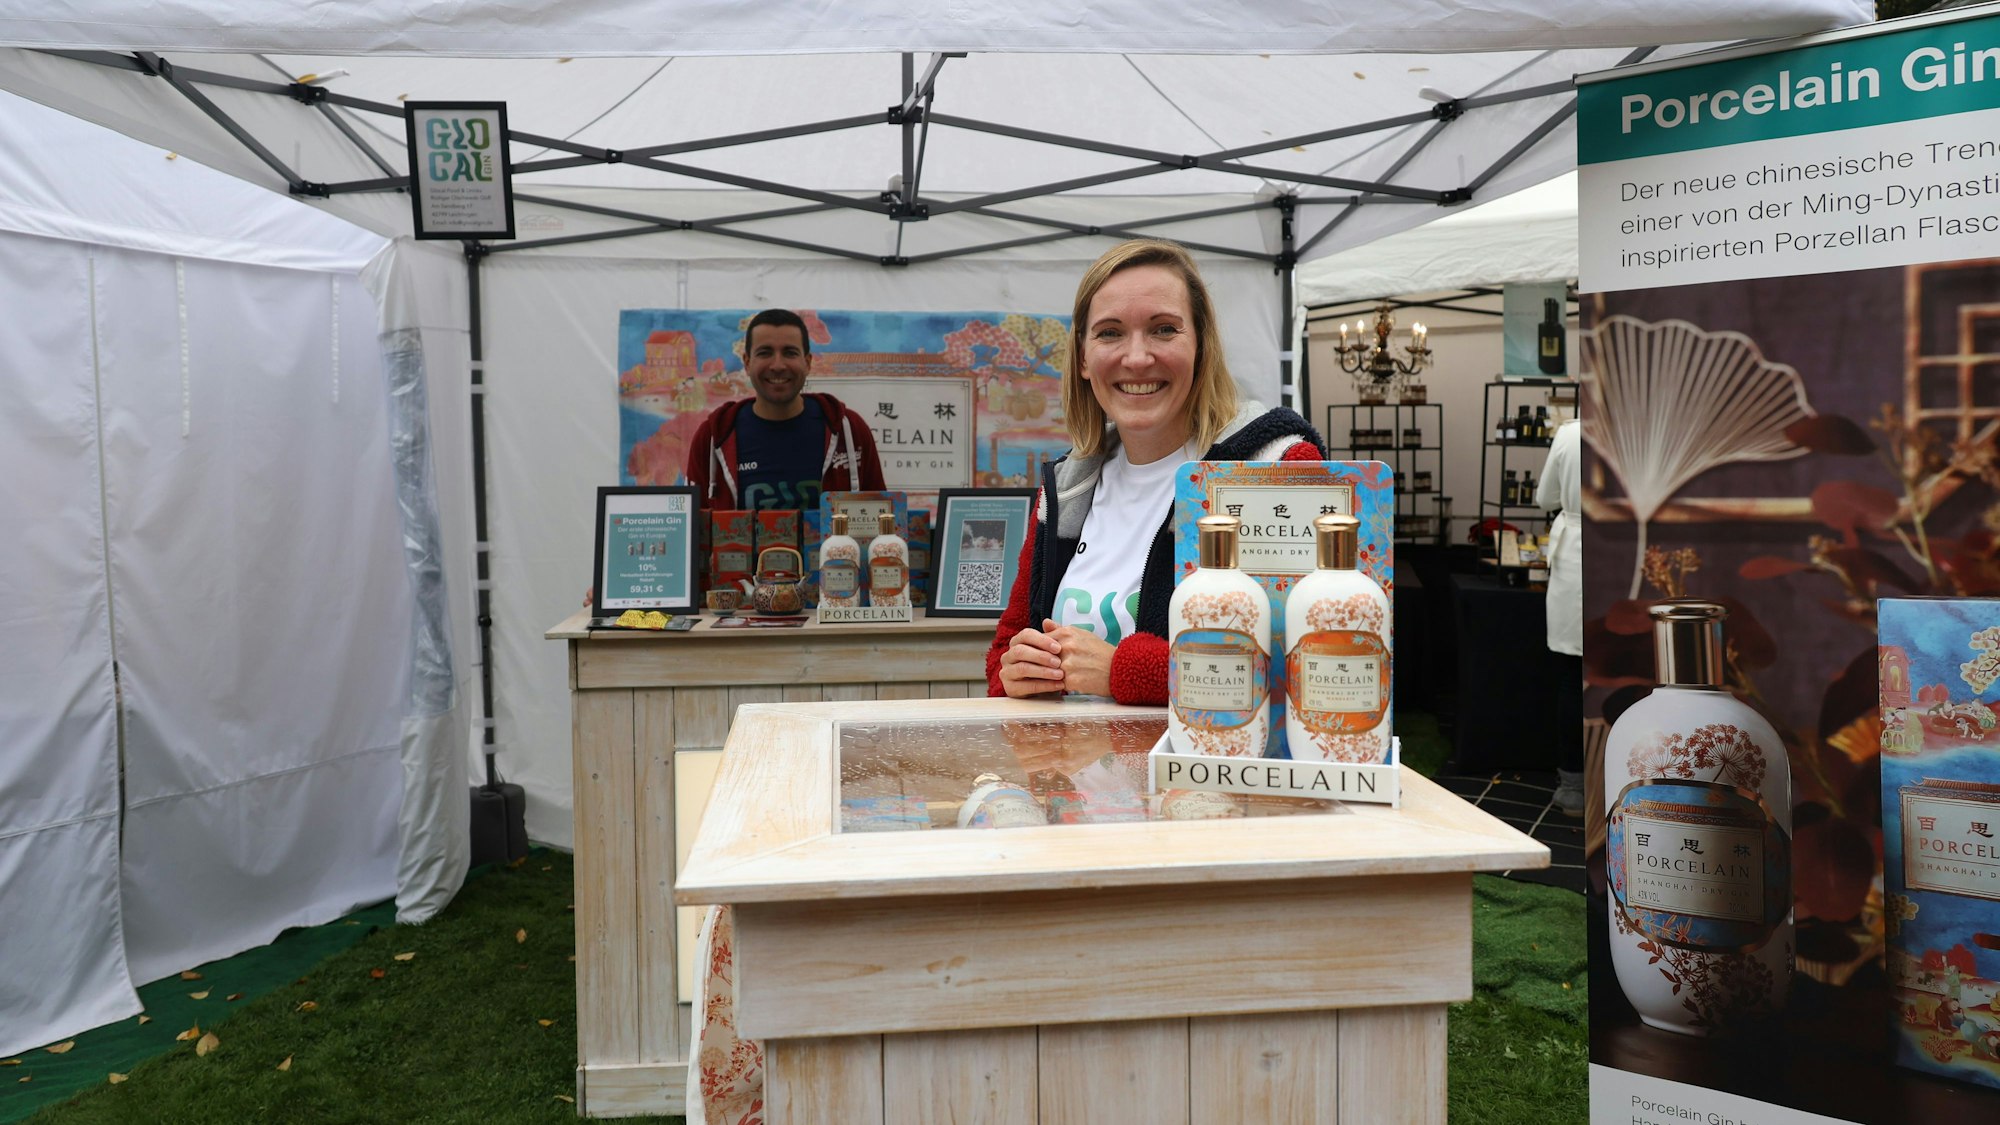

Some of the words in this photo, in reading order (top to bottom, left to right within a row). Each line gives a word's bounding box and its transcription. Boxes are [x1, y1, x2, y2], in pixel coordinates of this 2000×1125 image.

[1620, 61, 1880, 135] Porcelain
[1901, 41, 2000, 92] Gin
[425, 118, 490, 150] GLO
[428, 151, 493, 182] CAL
[484, 155, 492, 174] GIN
[1620, 180, 1664, 203] Der
[1672, 170, 1737, 197] neue
[1745, 149, 1914, 188] chinesische
[1925, 138, 2000, 167] Tren
[1620, 211, 1683, 235] einer
[1692, 205, 1738, 227] von
[1748, 198, 1793, 221] der
[1620, 236, 1764, 270] inspirierten
[1775, 222, 1906, 253] Porzellan
[737, 461, 758, 472] AKO
[896, 460, 921, 468] DRY
[930, 460, 954, 468] GIN
[622, 517, 664, 525] Porcelain
[666, 516, 682, 525] Gin
[1238, 524, 1313, 538] ORCELA
[638, 563, 657, 572] 10%
[630, 585, 654, 593] 59,31
[824, 609, 906, 619] PORCELAIN
[1183, 674, 1245, 686] PORCELAIN
[1308, 673, 1374, 685] PORCELAIN
[1168, 761, 1376, 794] PORCELAIN
[1635, 832, 1753, 858] 百思林
[1919, 837, 2000, 860] PORCEL
[1636, 853, 1751, 879] PORCELAIN
[1919, 862, 1982, 877] SHANGHAI
[1990, 871, 2000, 879] D
[1637, 877, 1695, 892] SHANGHAI
[1701, 886, 1725, 897] DRY
[1631, 1095, 1702, 1122] Porcelain
